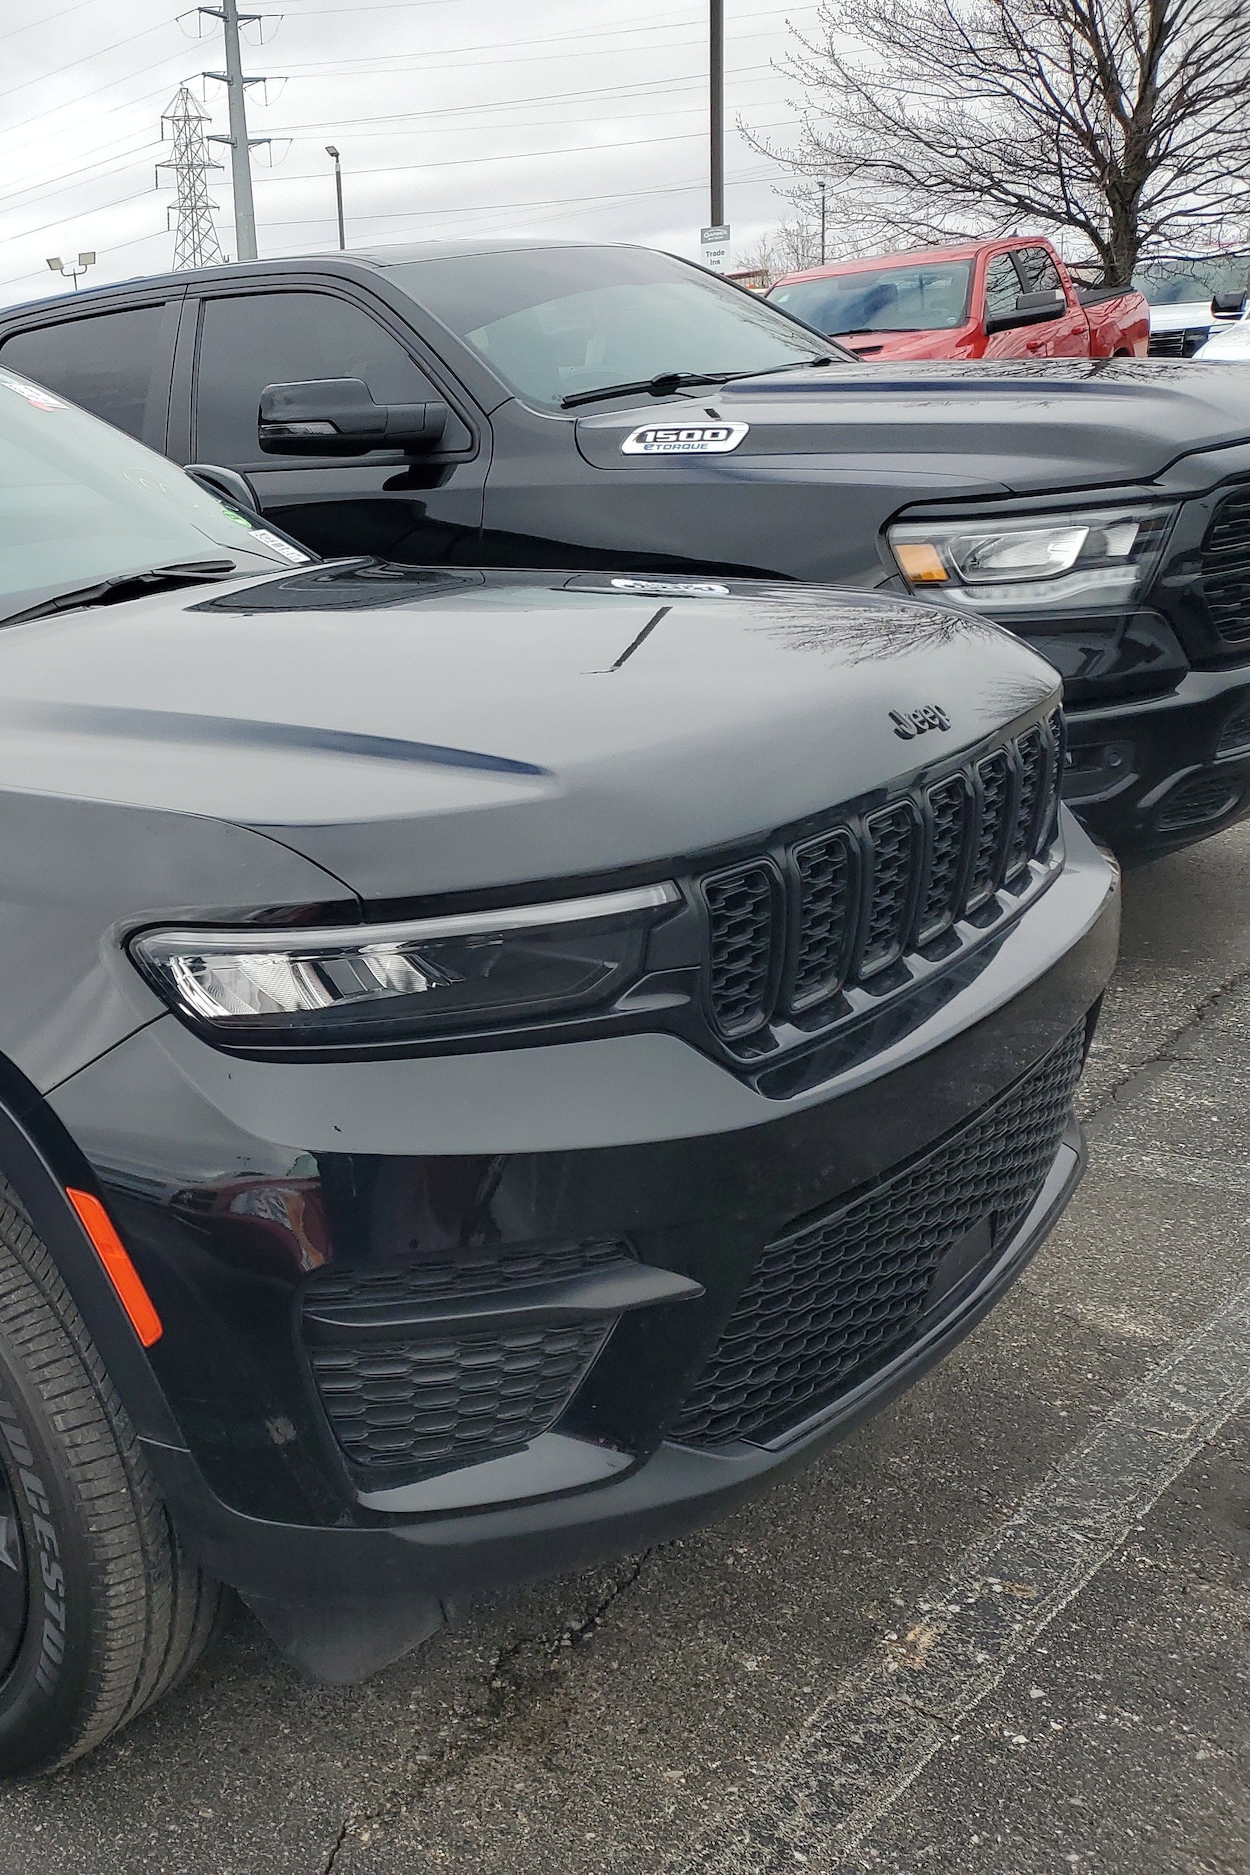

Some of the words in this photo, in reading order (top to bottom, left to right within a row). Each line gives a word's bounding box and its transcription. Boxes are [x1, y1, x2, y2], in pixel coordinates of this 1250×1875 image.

[705, 249, 726, 258] Trade
[643, 429, 729, 443] 1500
[888, 703, 951, 740] Jeep
